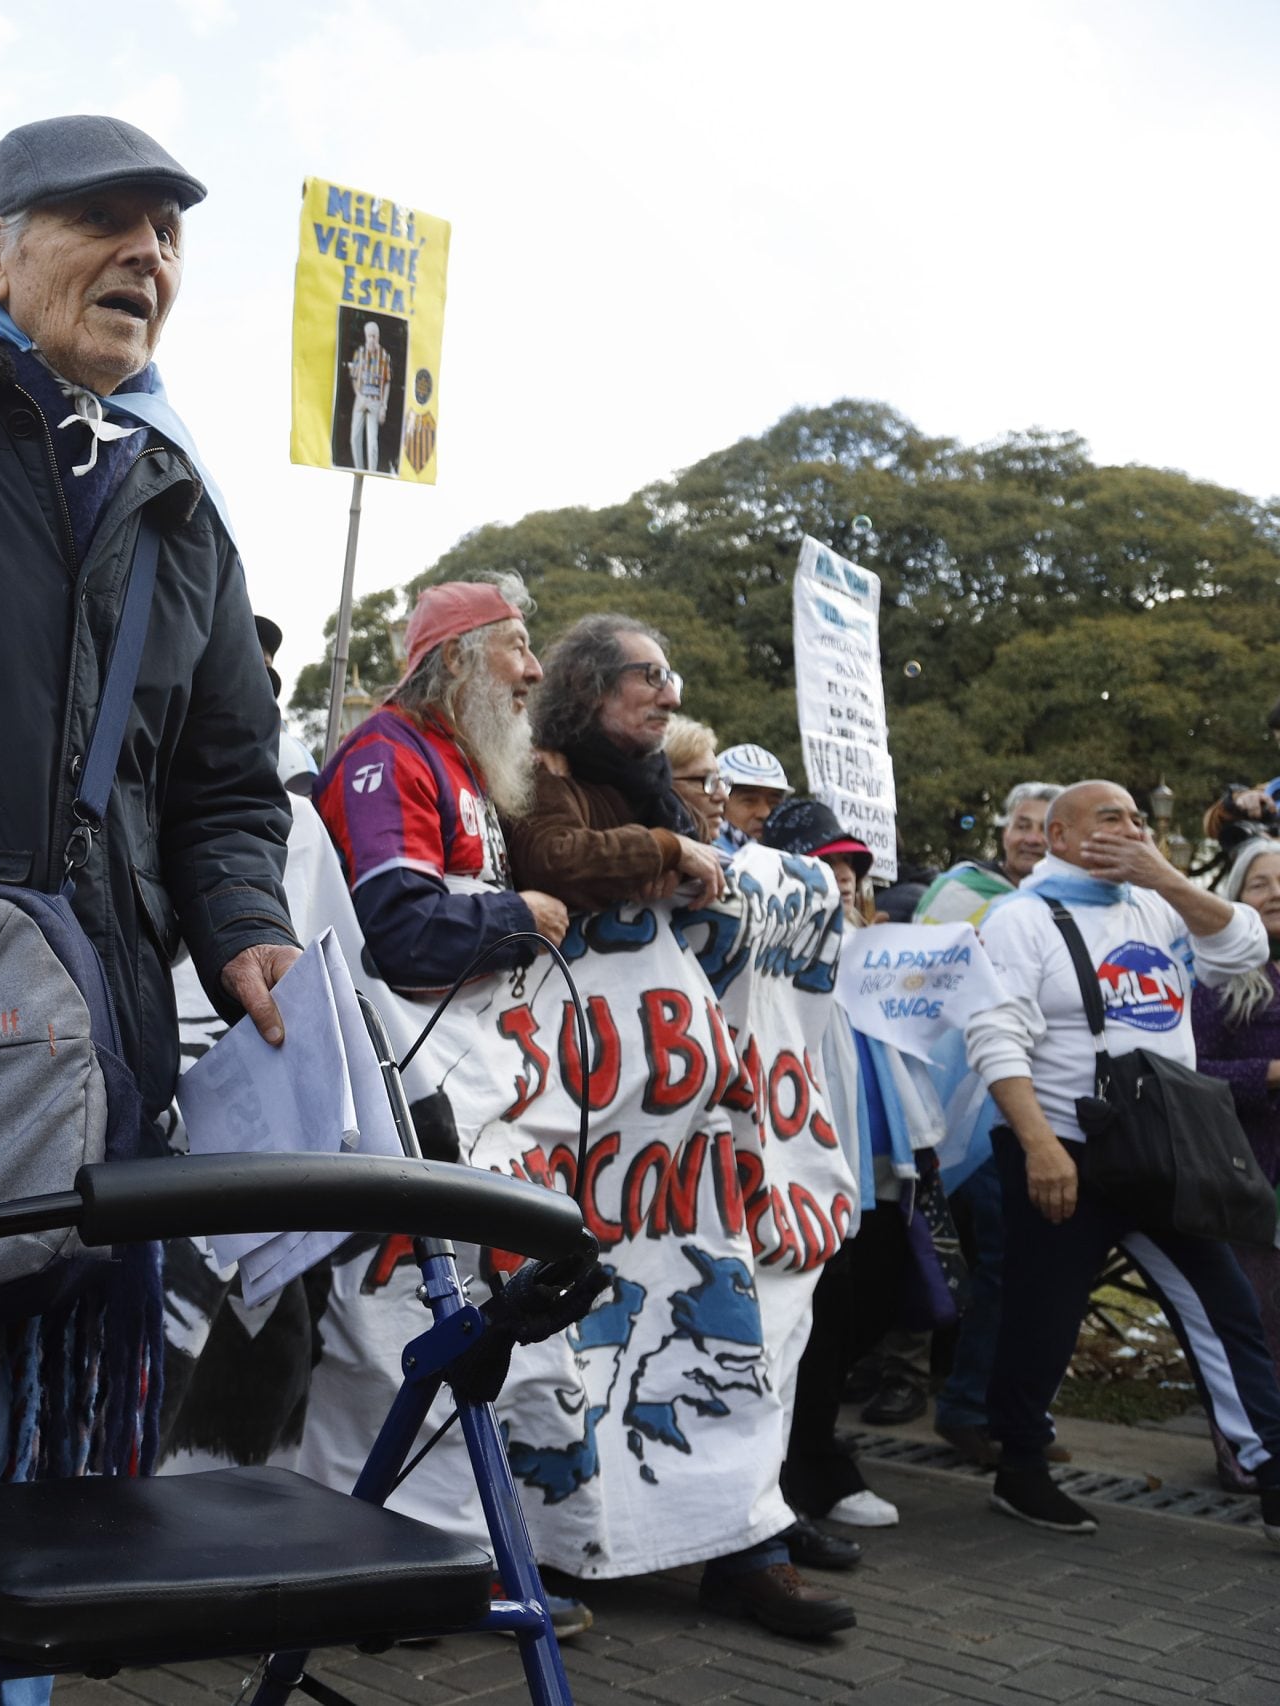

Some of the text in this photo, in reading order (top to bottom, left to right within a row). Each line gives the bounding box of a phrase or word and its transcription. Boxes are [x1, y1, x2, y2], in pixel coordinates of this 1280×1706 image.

[863, 944, 972, 969] LA PATRIA
[1098, 963, 1184, 1011] MLN
[879, 997, 945, 1020] VENDE
